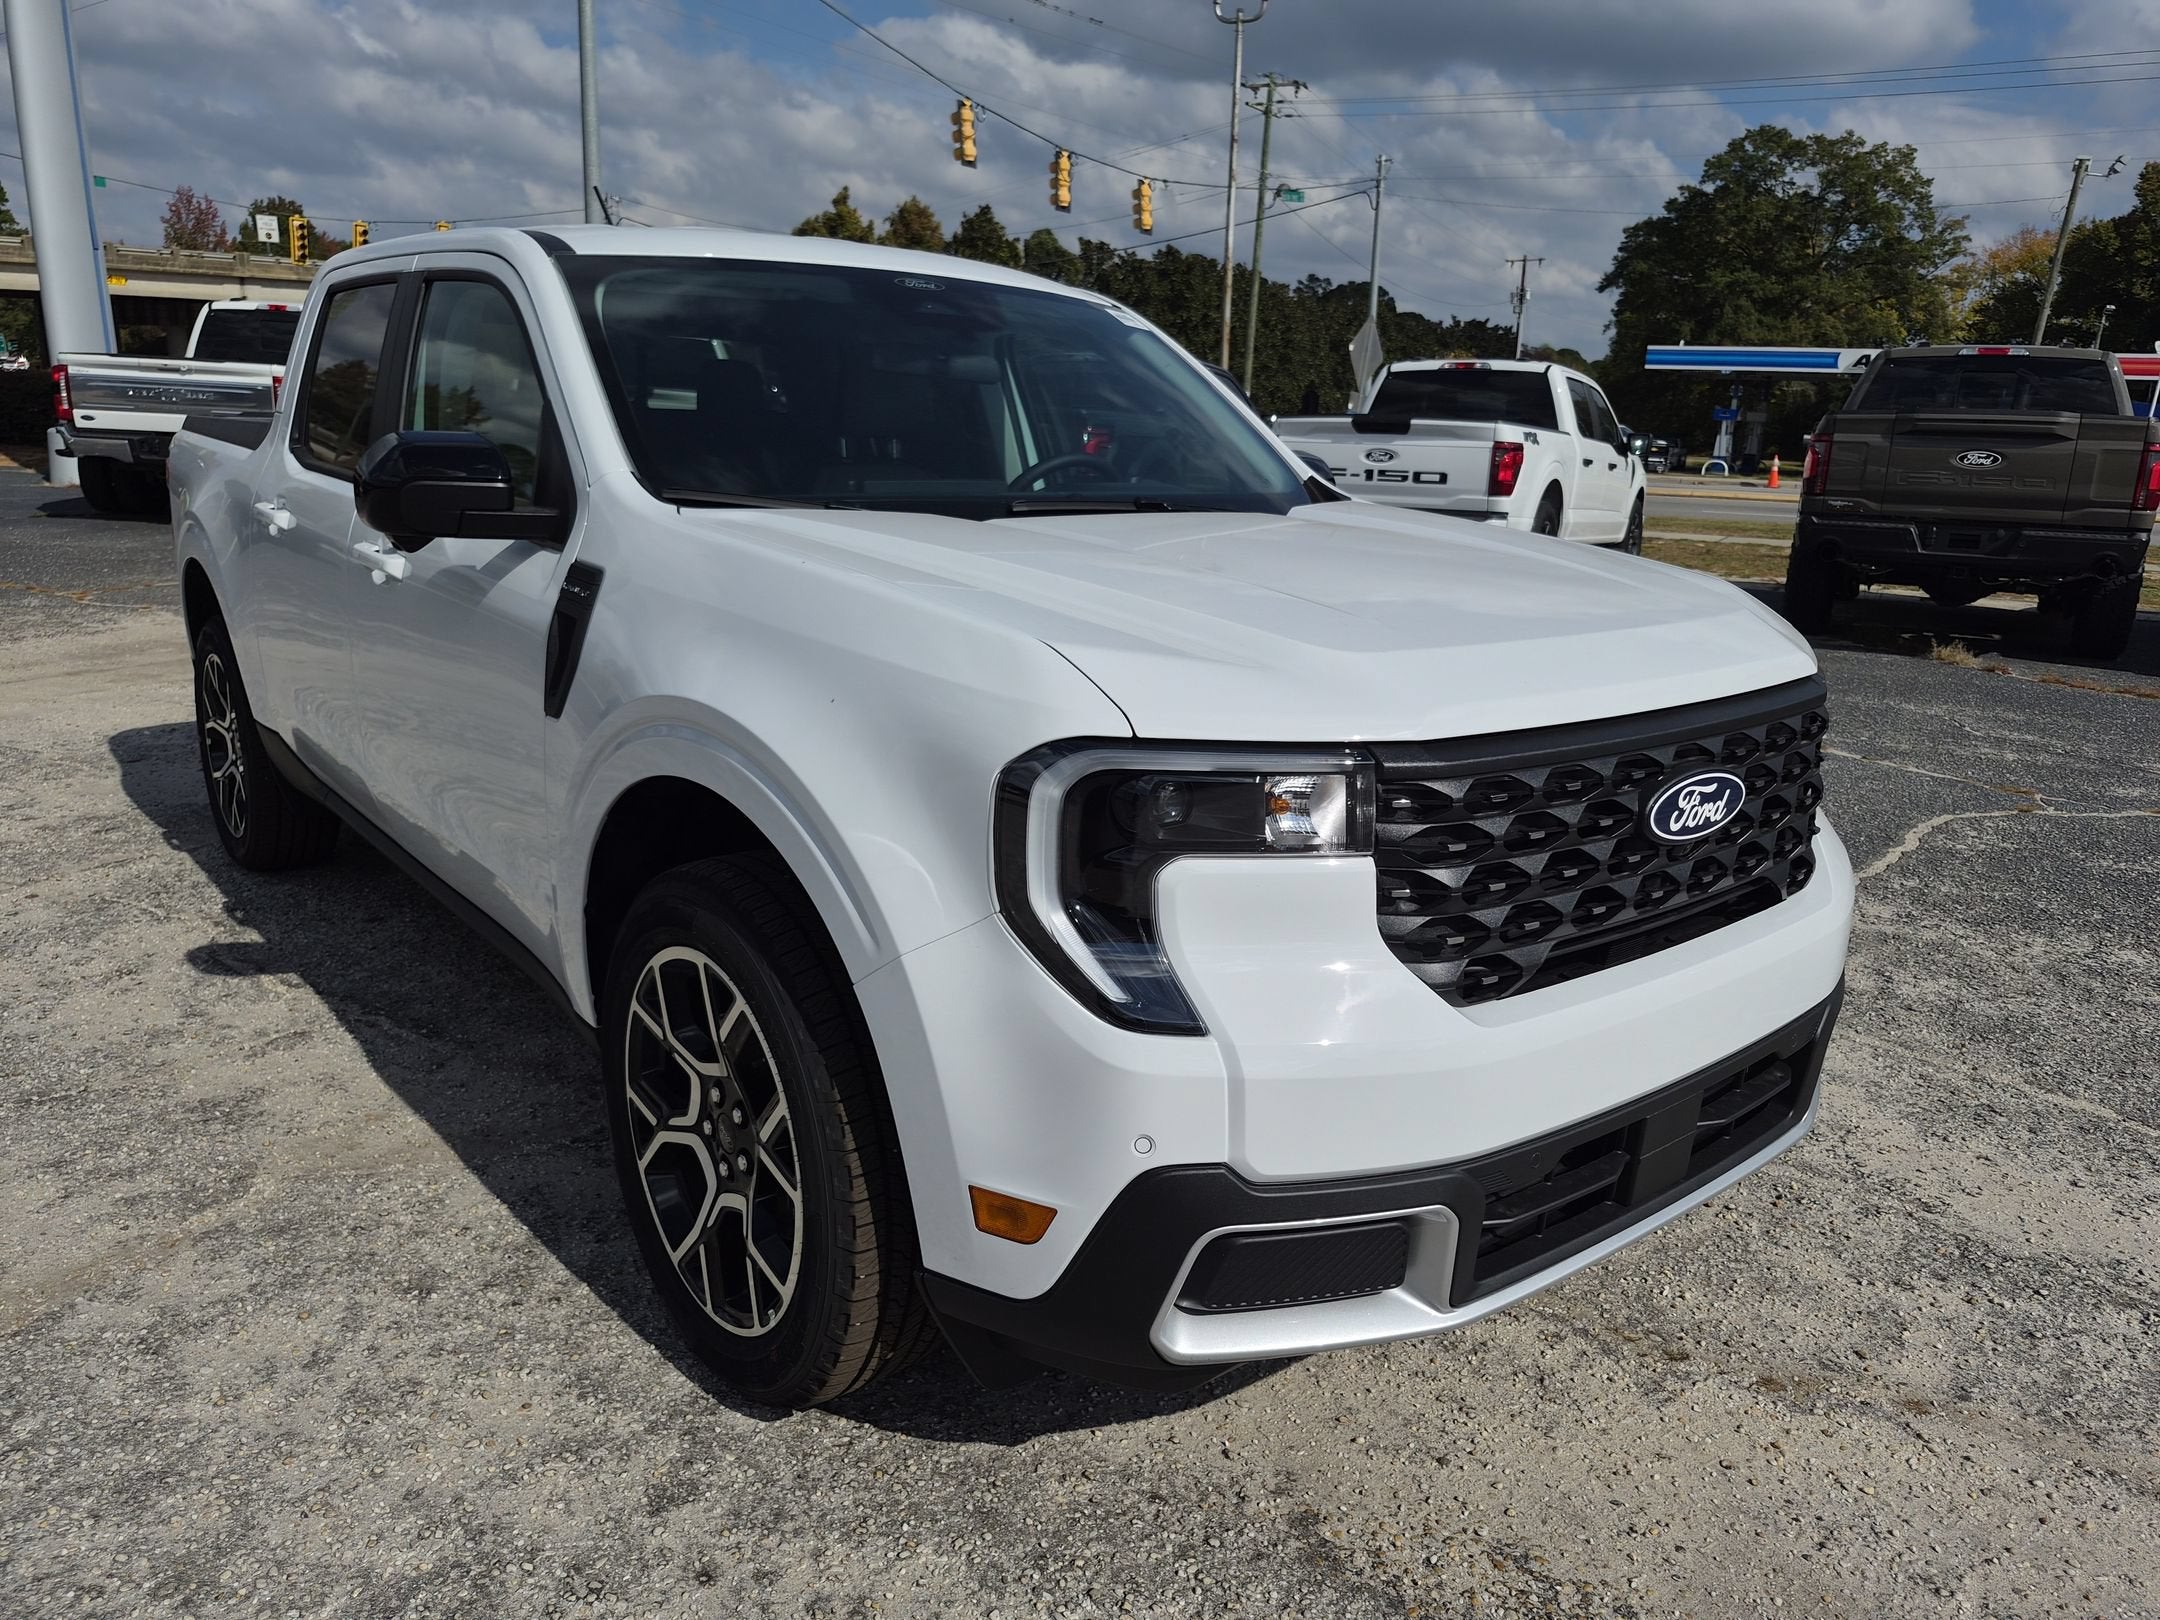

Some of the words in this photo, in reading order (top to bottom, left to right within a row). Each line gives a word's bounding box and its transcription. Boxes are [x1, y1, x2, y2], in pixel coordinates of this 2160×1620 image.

[1368, 450, 1393, 462] Ford
[1963, 452, 1994, 466] Ford
[1669, 782, 1731, 832] Ford
